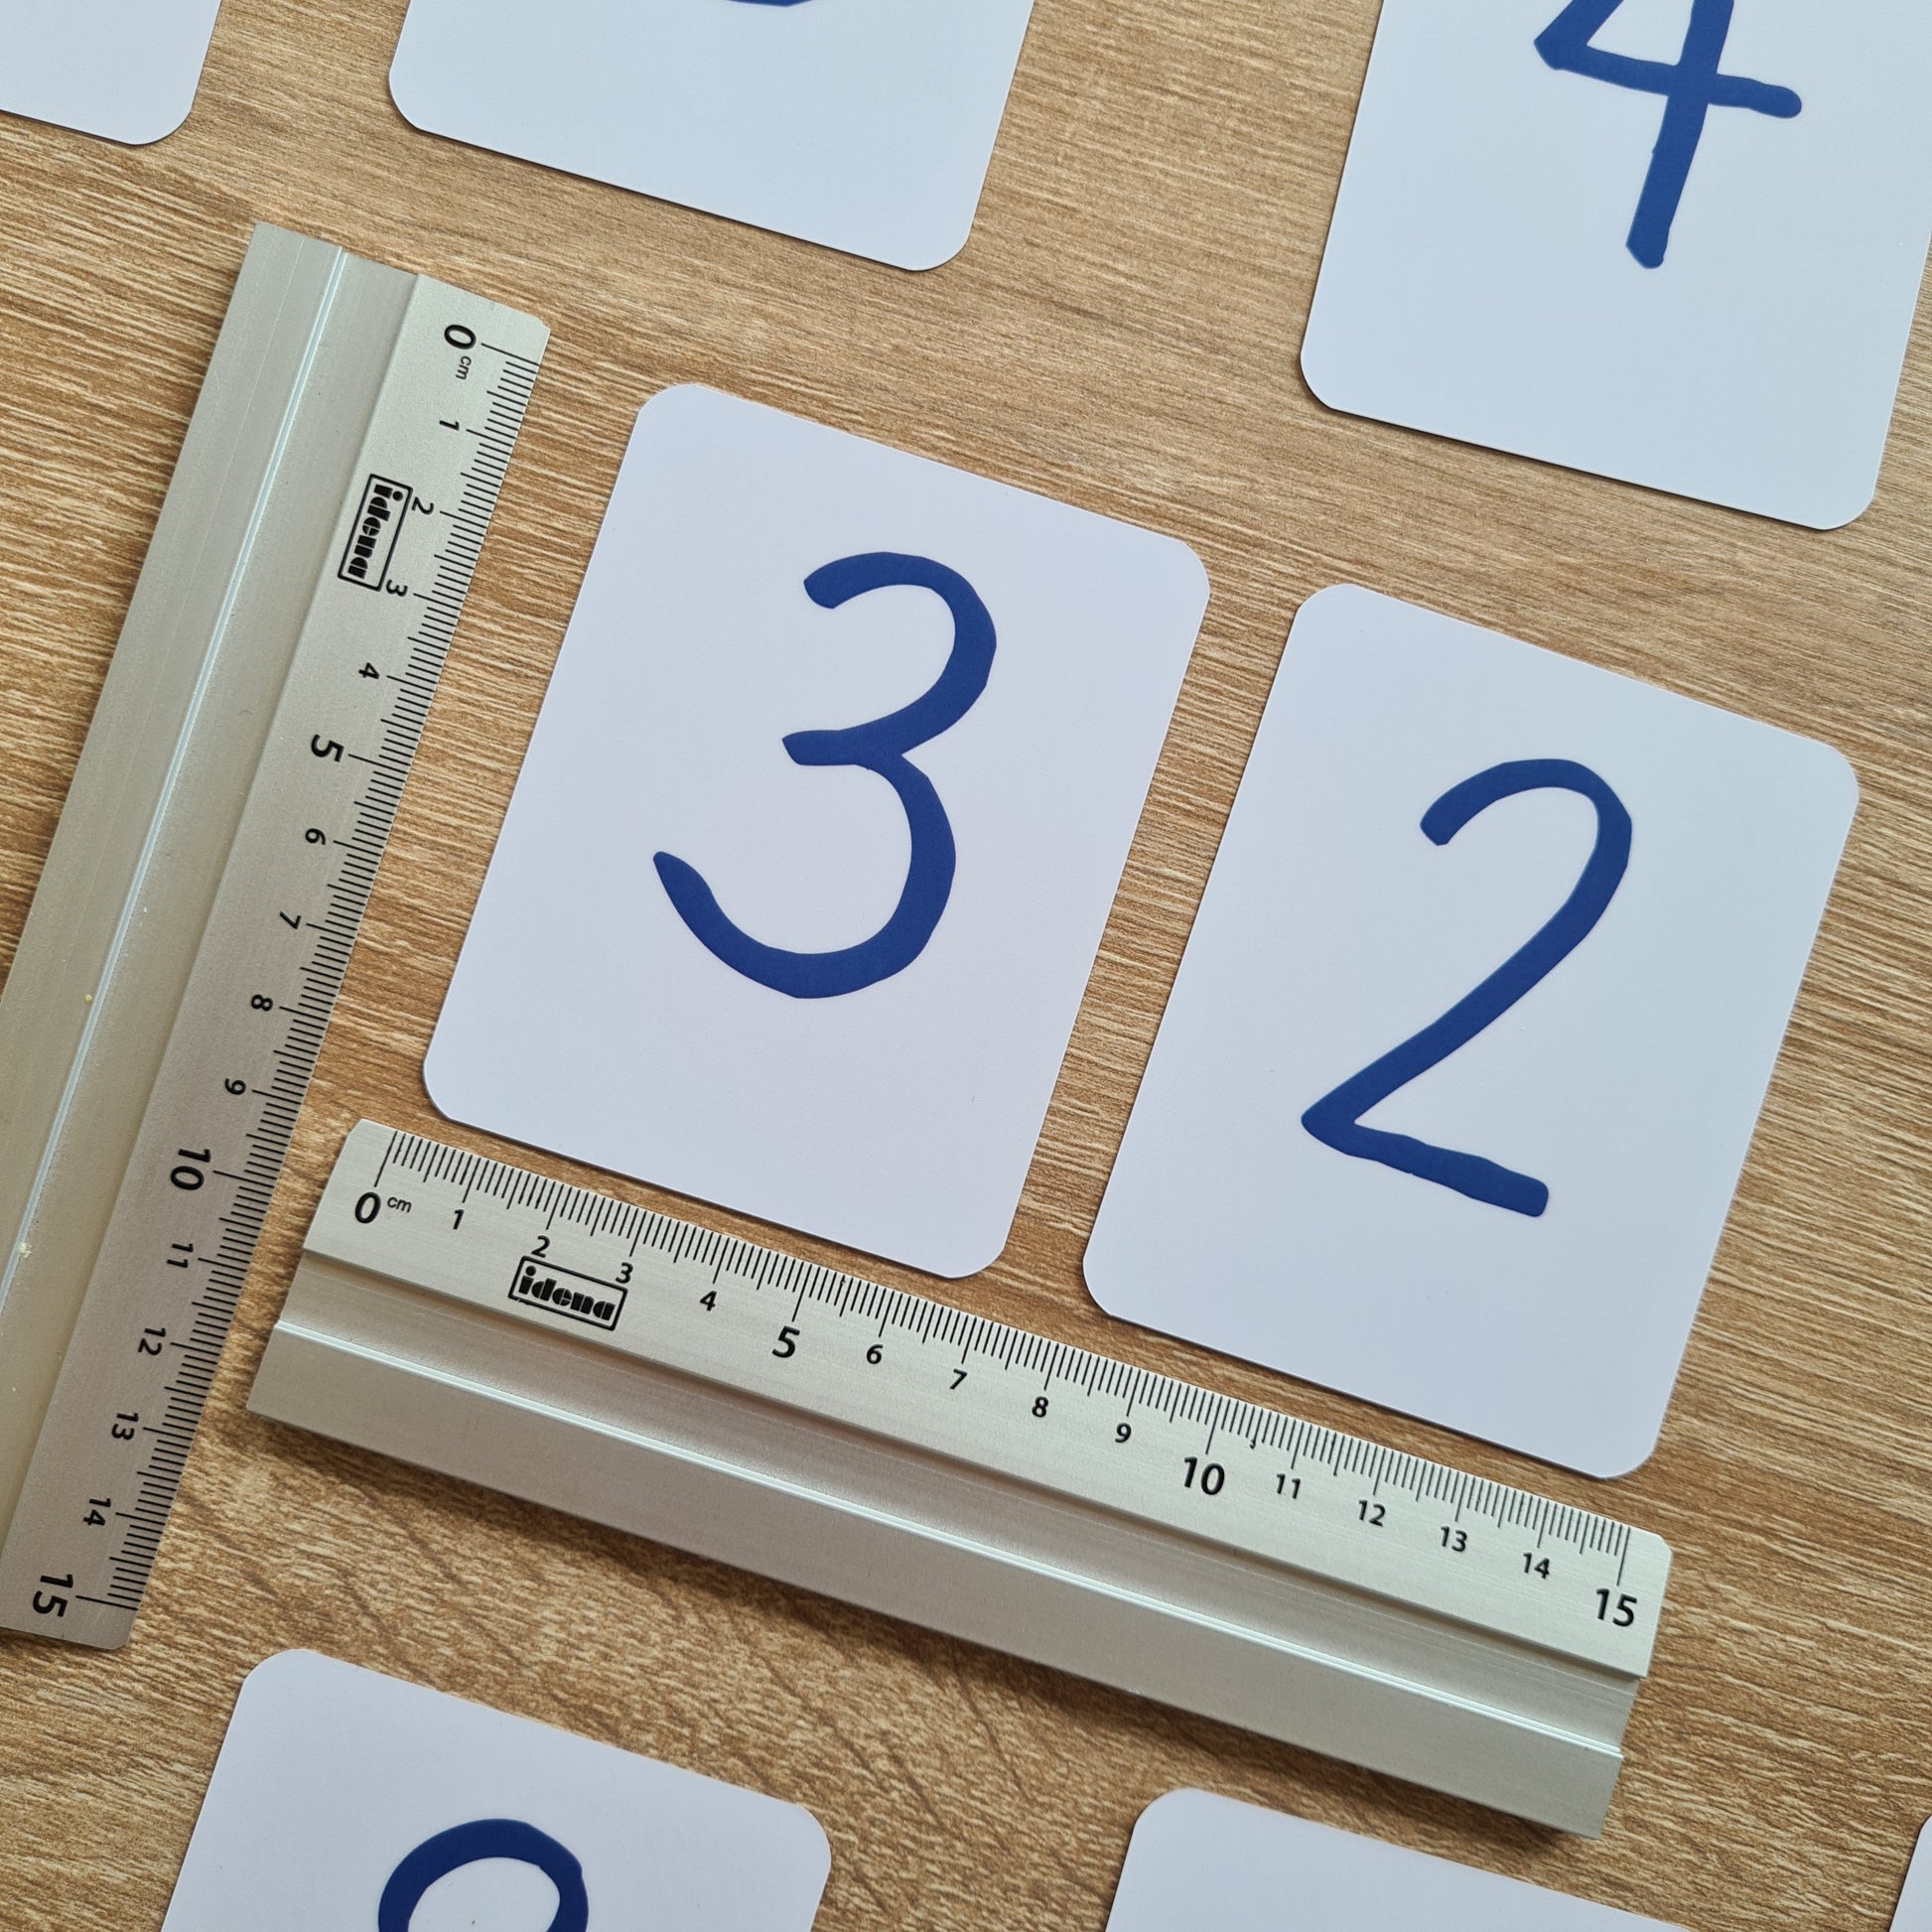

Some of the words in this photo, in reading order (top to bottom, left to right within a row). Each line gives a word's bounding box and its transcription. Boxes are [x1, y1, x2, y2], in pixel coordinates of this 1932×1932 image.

[1534, 0, 1802, 269] 4
[444, 324, 477, 350] 0
[455, 355, 473, 380] cm
[439, 420, 460, 431] 1
[411, 495, 435, 515] 2
[347, 483, 404, 580] idena
[385, 579, 408, 598] 3
[357, 662, 380, 680] 4
[310, 734, 345, 762] 5
[653, 552, 997, 999] 3
[304, 828, 327, 846] 6
[279, 911, 302, 930] 7
[1302, 759, 1633, 1218] 2
[250, 994, 274, 1013] 8
[223, 1077, 247, 1096] 9
[170, 1148, 211, 1191] 10
[166, 1243, 195, 1269] 11
[518, 1265, 616, 1321] idena
[137, 1327, 167, 1356] 12
[354, 1191, 381, 1224] 0
[386, 1196, 412, 1213] cm
[453, 1208, 465, 1230] 1
[530, 1235, 551, 1259] 2
[615, 1262, 633, 1285] 3
[699, 1290, 718, 1311] 4
[771, 1325, 800, 1359] 5
[866, 1343, 884, 1365] 6
[949, 1368, 968, 1390] 7
[1032, 1396, 1049, 1419] 8
[1114, 1423, 1132, 1444] 9
[1183, 1456, 1225, 1496] 10
[1276, 1473, 1302, 1500] 11
[1358, 1500, 1386, 1527] 12
[1441, 1526, 1468, 1553] 13
[1523, 1552, 1550, 1580] 14
[1595, 1588, 1638, 1627] 15
[110, 1412, 139, 1441] 13
[82, 1497, 112, 1526] 14
[32, 1574, 74, 1618] 15
